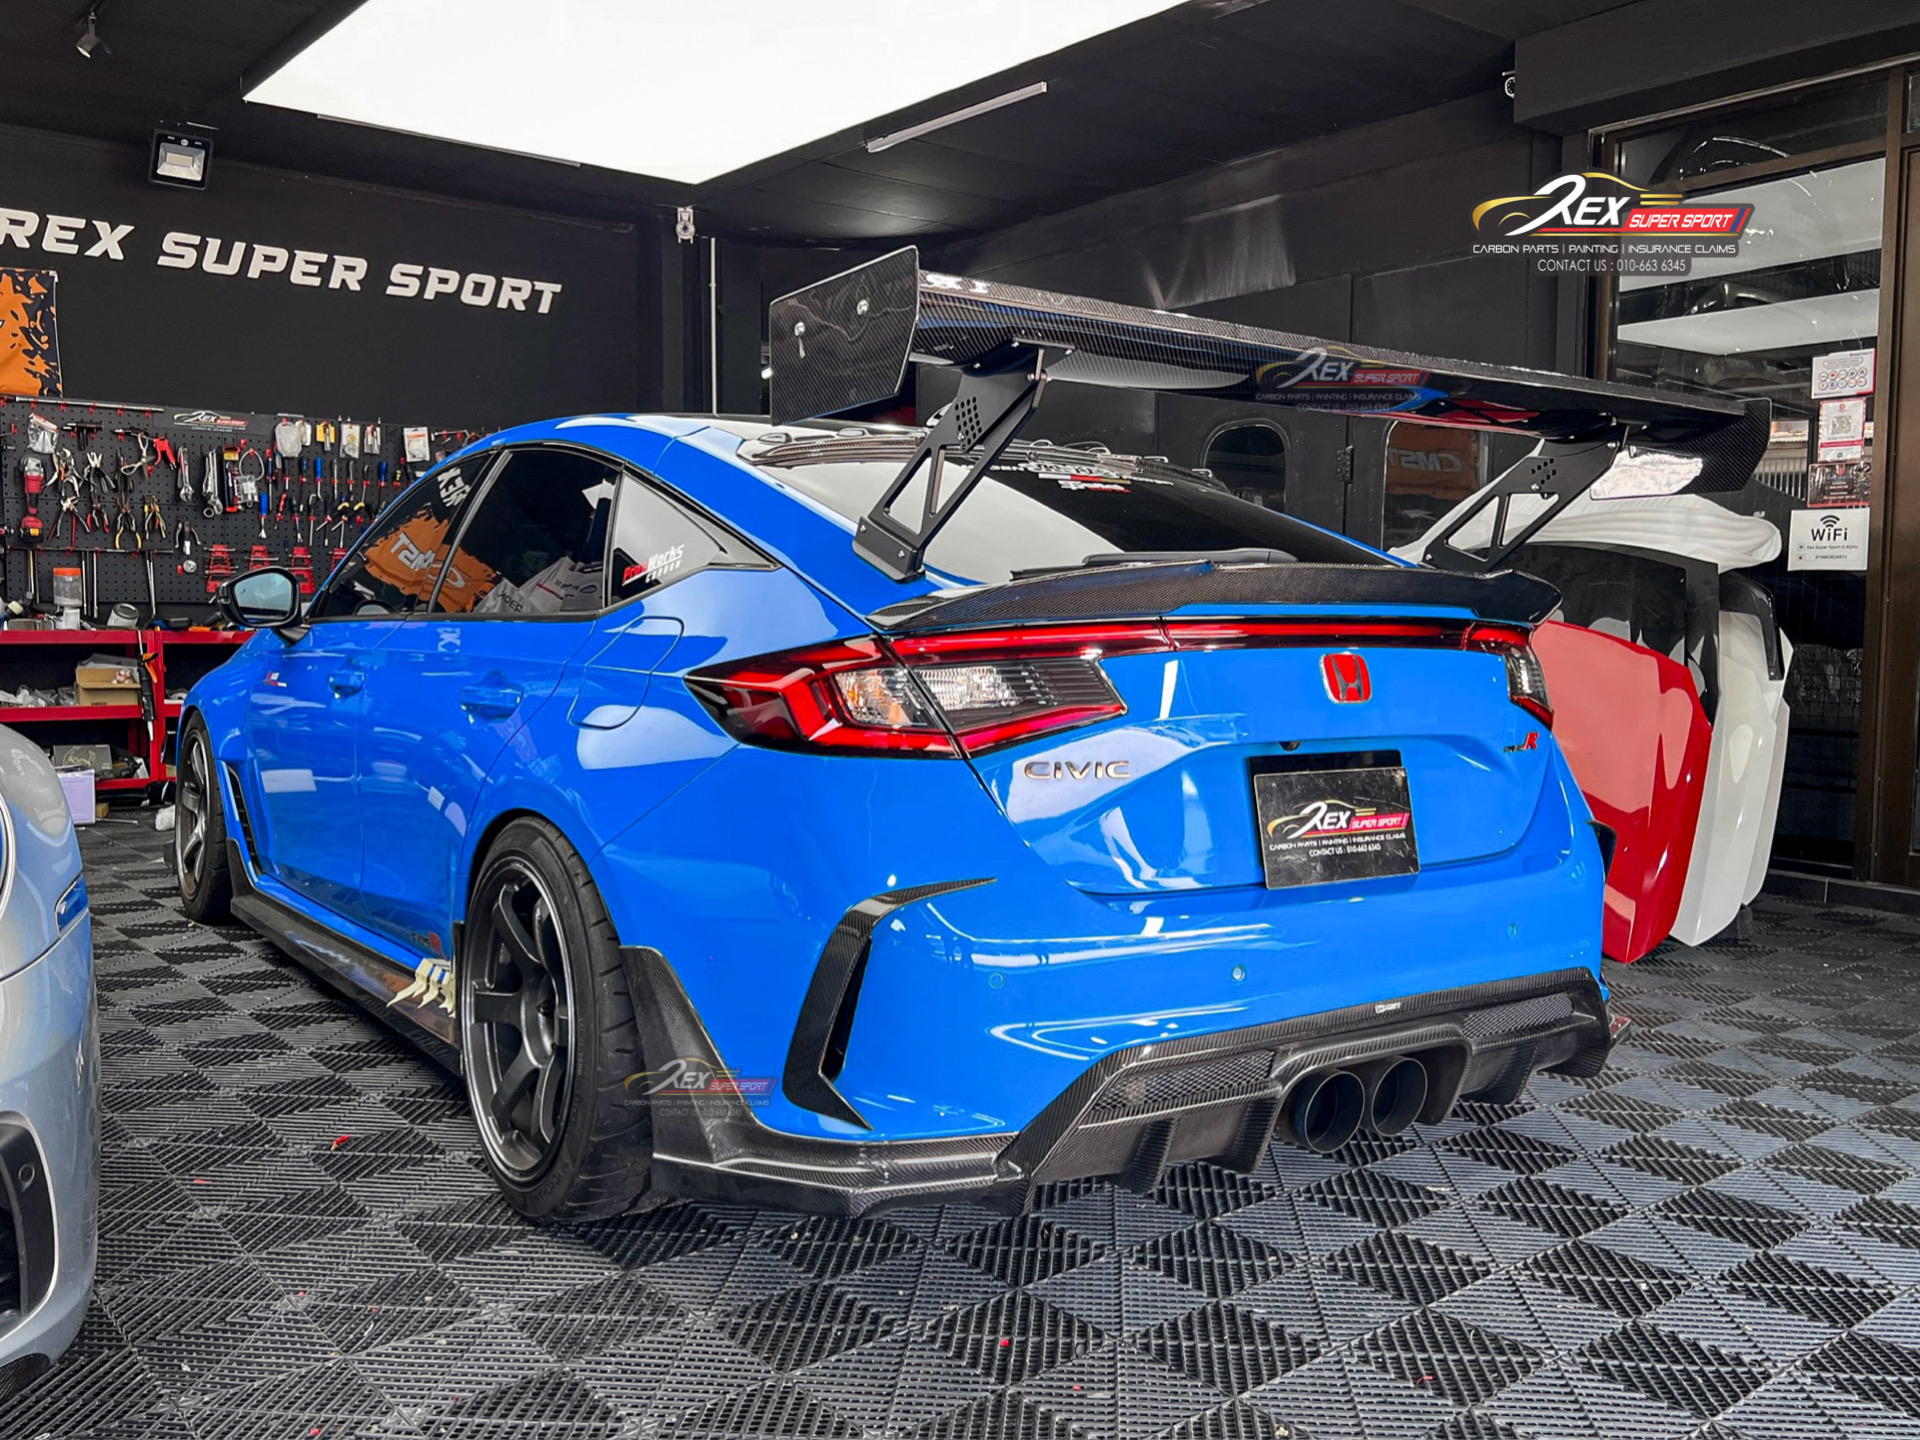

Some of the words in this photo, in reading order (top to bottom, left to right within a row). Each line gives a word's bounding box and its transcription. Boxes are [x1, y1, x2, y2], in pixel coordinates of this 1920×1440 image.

[0, 208, 135, 260] REX
[157, 231, 368, 292] SUPER
[385, 263, 562, 314] SPORT
[1811, 527, 1848, 541] WiFi
[1024, 761, 1131, 780] CIVIC
